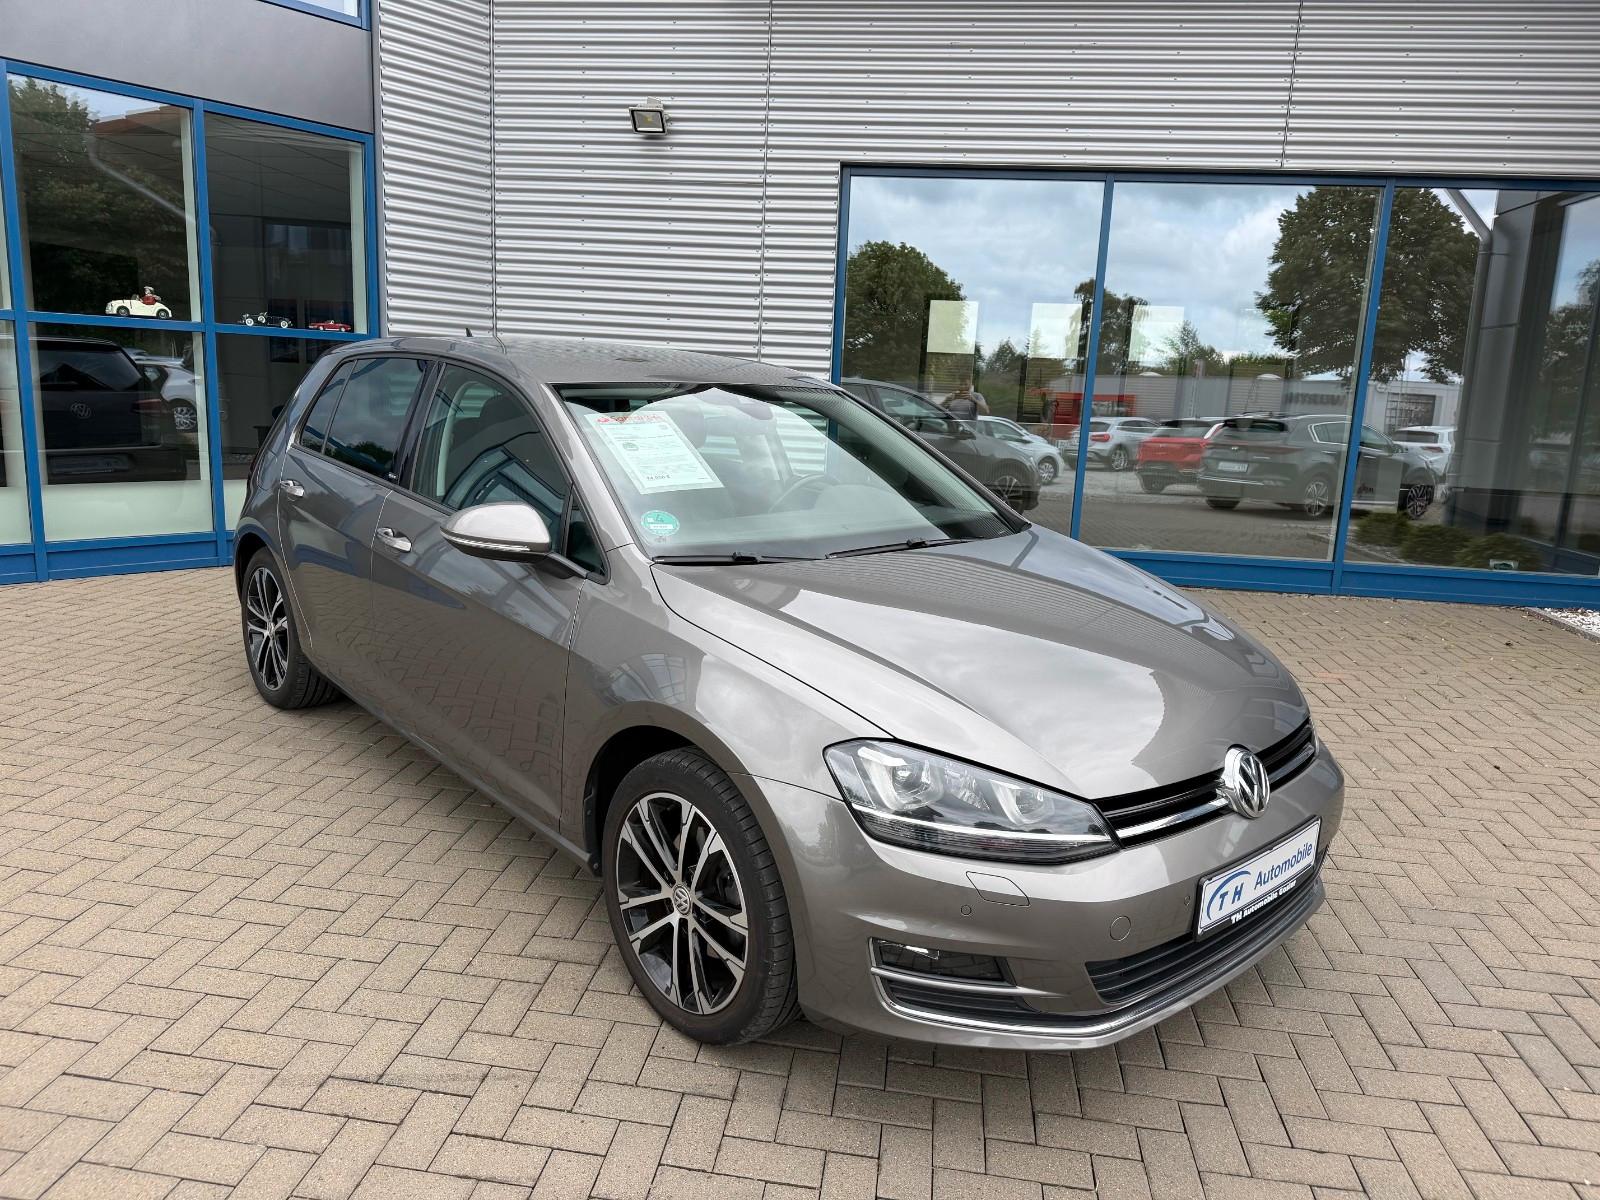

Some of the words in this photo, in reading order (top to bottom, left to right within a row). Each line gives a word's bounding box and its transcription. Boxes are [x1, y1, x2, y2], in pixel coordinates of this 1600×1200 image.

[1254, 842, 1313, 890] Automobile
[1230, 911, 1243, 924] TH
[1243, 892, 1278, 918] Automobile
